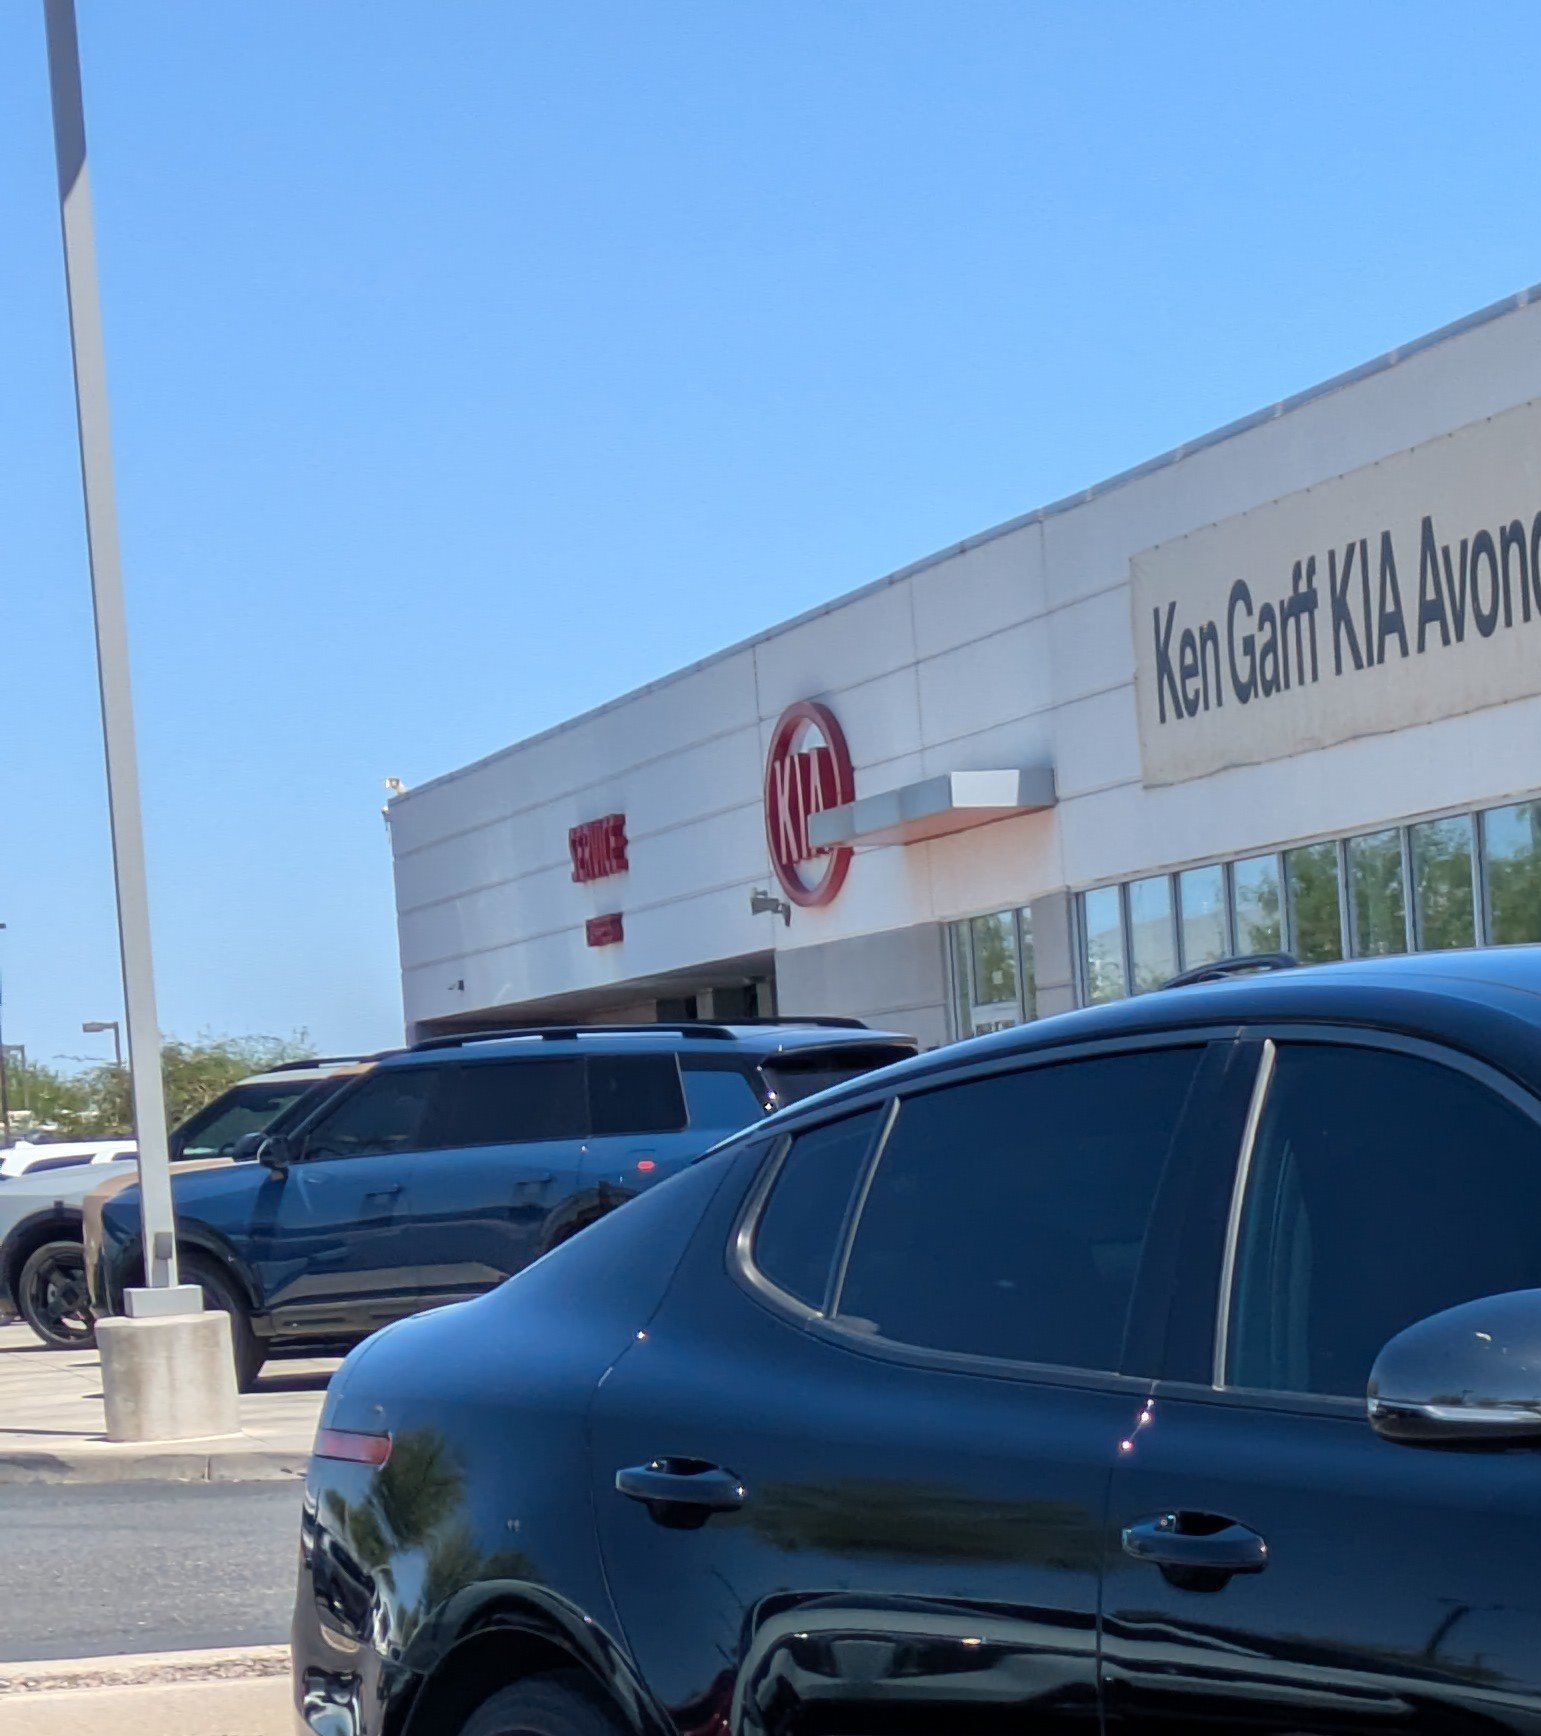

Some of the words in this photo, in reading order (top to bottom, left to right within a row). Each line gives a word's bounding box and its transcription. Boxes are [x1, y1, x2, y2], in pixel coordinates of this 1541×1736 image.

[1153, 600, 1223, 725] Ken
[1226, 554, 1320, 706] Garff
[1327, 528, 1410, 677] KIA
[773, 746, 845, 866] KIA
